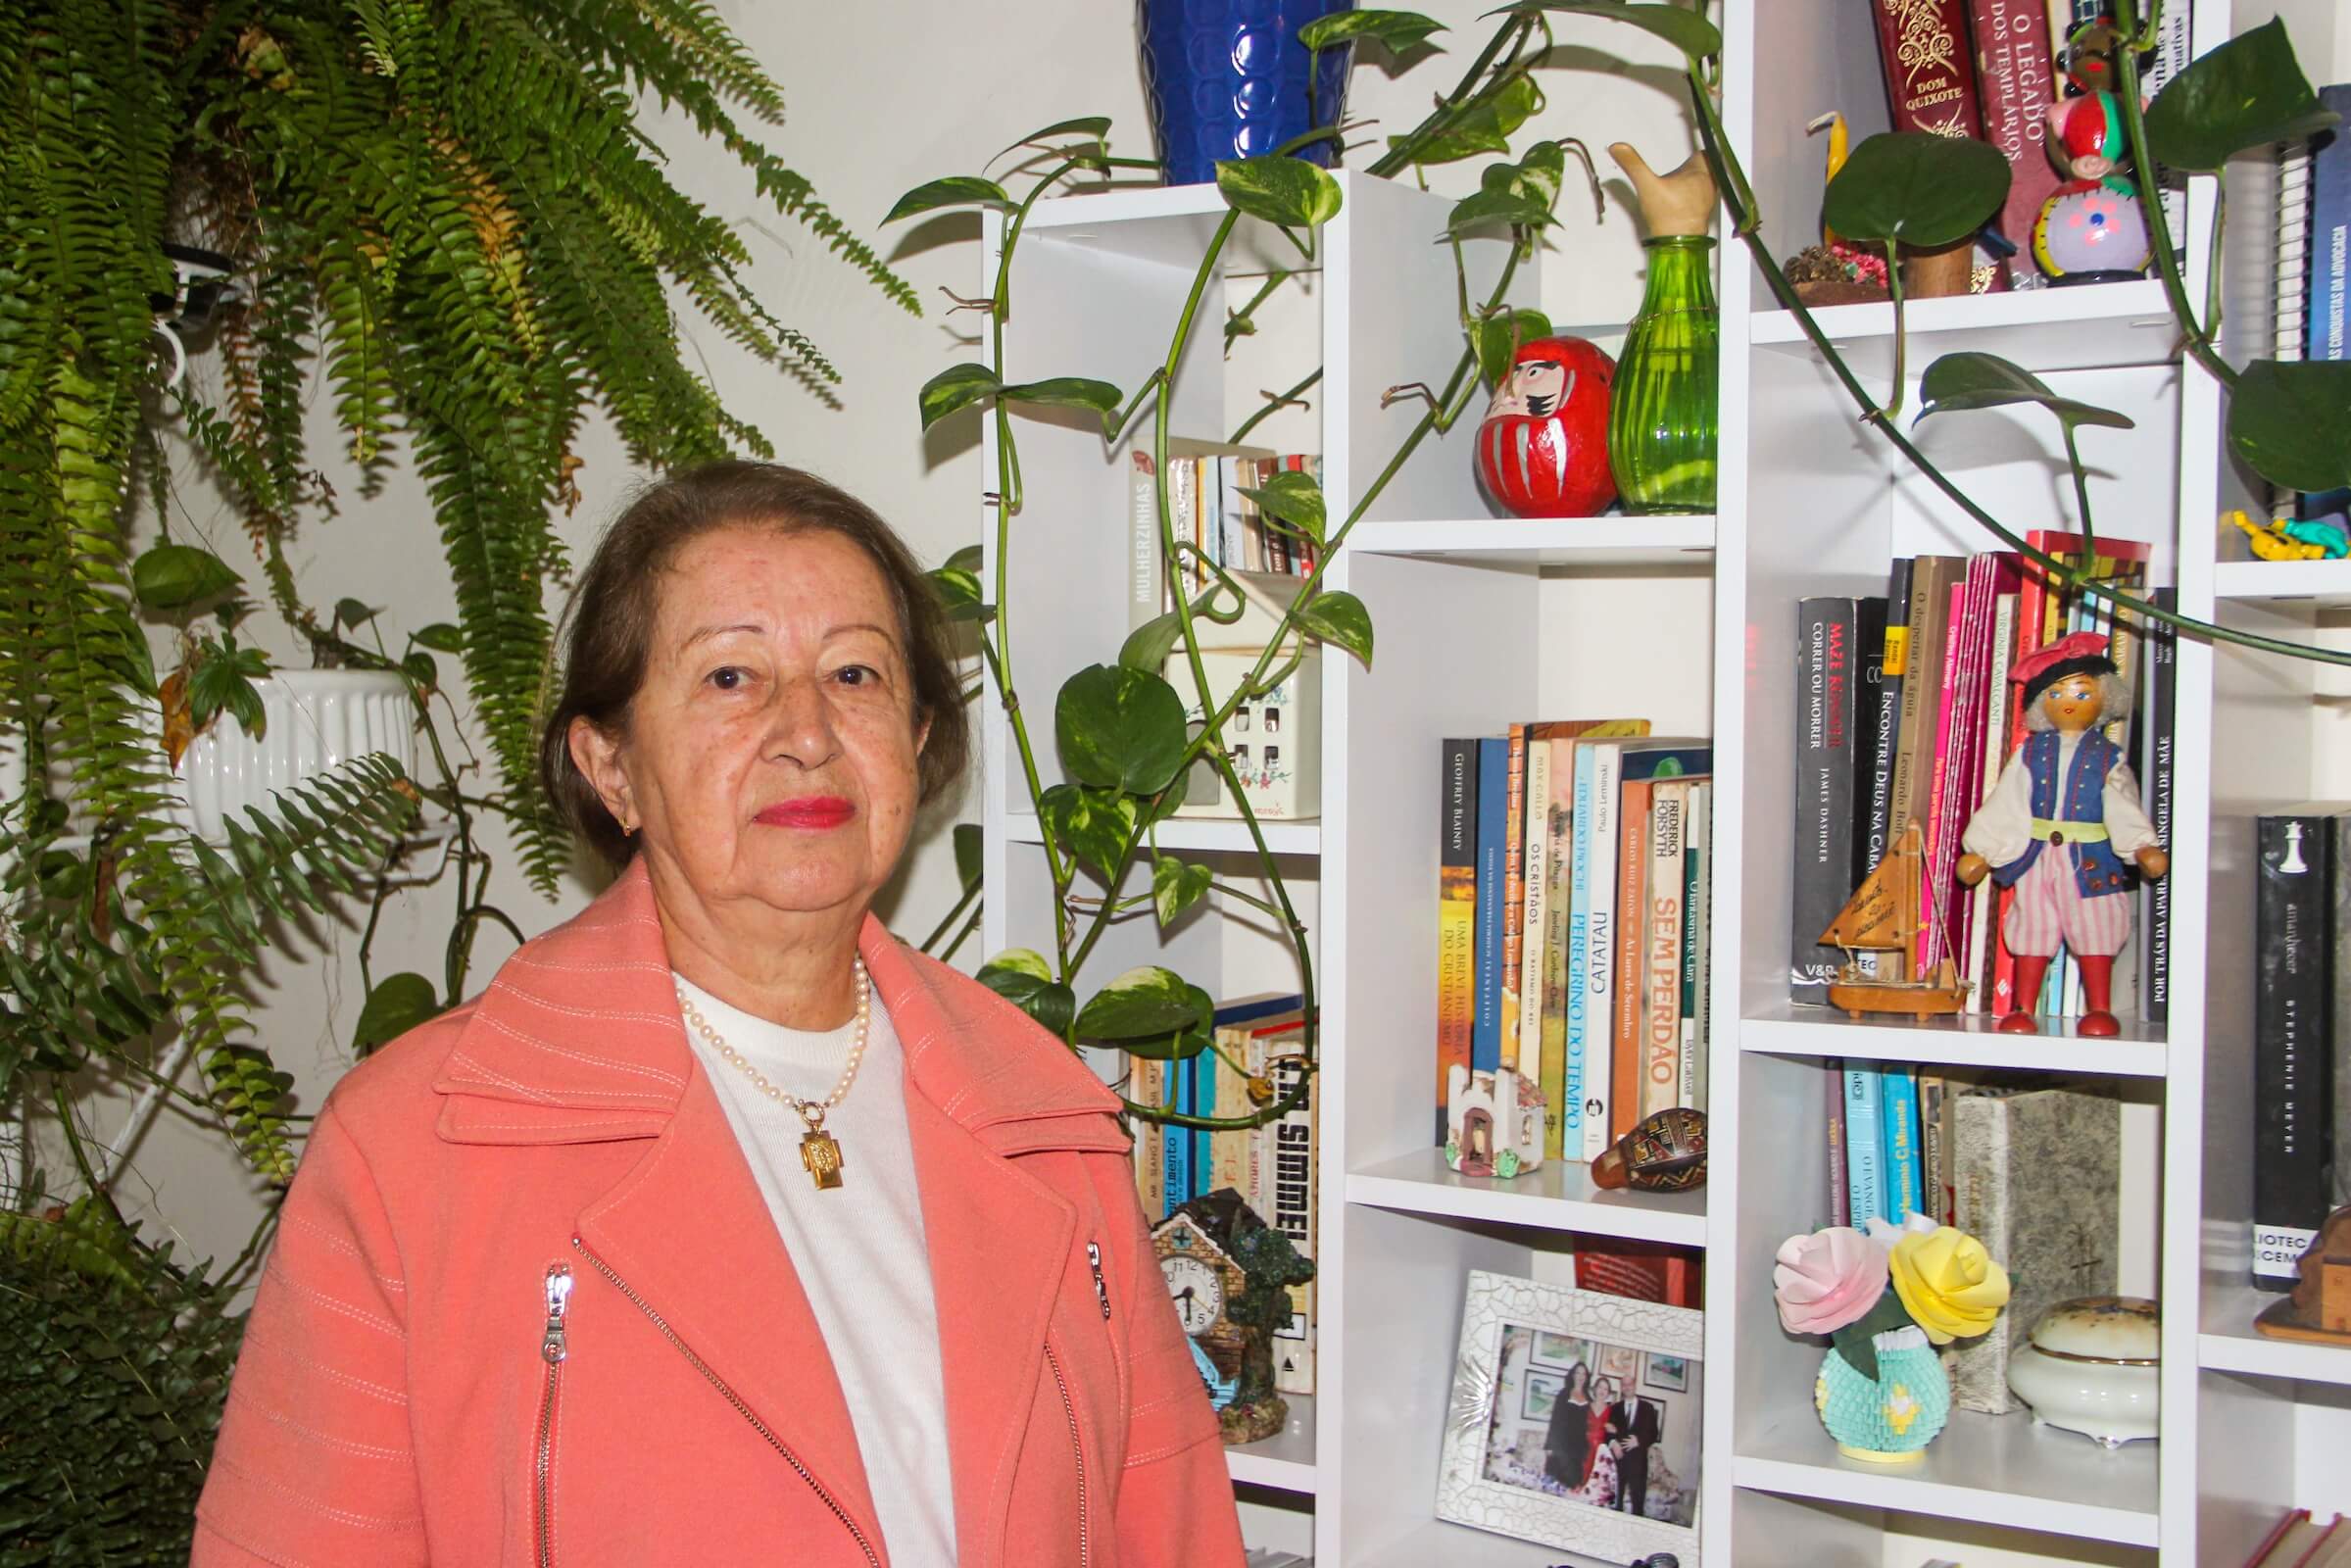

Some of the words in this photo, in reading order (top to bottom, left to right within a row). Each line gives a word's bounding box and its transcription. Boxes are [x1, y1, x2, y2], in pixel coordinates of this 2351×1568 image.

[1990, 2, 2007, 40] DOS
[2012, 15, 2031, 32] O
[1906, 86, 1963, 111] QUIXOTE
[1916, 76, 1947, 94] DOM
[1995, 45, 2023, 161] TEMPLÁRIOS
[2016, 42, 2044, 141] LEGADO
[2329, 225, 2346, 276] ADVOCACIA
[2329, 278, 2344, 291] DA
[2328, 292, 2344, 348] CONQUISTAS
[1136, 484, 1151, 603] MULHERZINHAS
[1917, 593, 1925, 603] O
[1812, 621, 1824, 672] CORRER
[1829, 622, 1843, 670] MAZE
[1911, 608, 1924, 660] despertar
[1996, 612, 2008, 657] VIRGINIA
[1811, 674, 1823, 693] OU
[1910, 666, 1918, 679] da
[1905, 685, 1918, 717] águia
[1990, 662, 2004, 726] CAVALCANTI
[1810, 697, 1822, 749] MORRER
[1876, 692, 1894, 766] ENCONTRE
[2157, 736, 2170, 764] MÃE
[1453, 753, 1465, 806] GEOFFREY
[1598, 764, 1608, 805] Leminski
[1820, 767, 1830, 803] JAMES
[1873, 771, 1887, 808] DEUS
[1897, 752, 1911, 806] Leonardo
[2158, 770, 2169, 788] DE
[1452, 808, 1464, 851] BLAINEY
[1598, 808, 1607, 831] Paulo
[1656, 800, 1668, 858] FORSYTH
[1669, 800, 1679, 858] FREDERICK
[1819, 808, 1829, 862] DASHNER
[1871, 811, 1883, 830] NA
[2156, 791, 2169, 846] SINGELA
[1531, 844, 1541, 860] OS
[1867, 834, 1882, 874] CABA
[1529, 863, 1542, 925] CRISTÃOS
[1444, 930, 1454, 948] DO
[1456, 920, 1466, 949] UMA
[1654, 898, 1678, 960] SEM
[2155, 921, 2166, 938] DA
[2283, 904, 2302, 975] amanhecer
[1456, 954, 1466, 990] BREVE
[1569, 913, 1586, 1020] PEREGRINO
[1592, 911, 1608, 994] CATATAU
[2153, 941, 2165, 974] TRÁS
[1442, 953, 1454, 1047] CRISTIANISMO
[1624, 980, 1633, 992] de
[2154, 977, 2165, 1003] POR
[1623, 994, 1634, 1039] Setembro
[1650, 969, 1678, 1084] PERDÃO
[1568, 1028, 1583, 1055] DO
[2284, 1000, 2294, 1091] STEPHENIE
[1567, 1063, 1581, 1129] TEMPO
[1894, 1100, 1908, 1147] Miranda
[2283, 1102, 2294, 1153] MEYER
[1249, 1151, 1259, 1199] AMORES
[1863, 1156, 1873, 1165] O
[1851, 1185, 1861, 1194] O
[1174, 1262, 1183, 1272] 11
[1186, 1260, 1198, 1271] 12
[1210, 1277, 1216, 1288] 2
[1213, 1291, 1219, 1302] 3
[1198, 1313, 1205, 1324] 5
